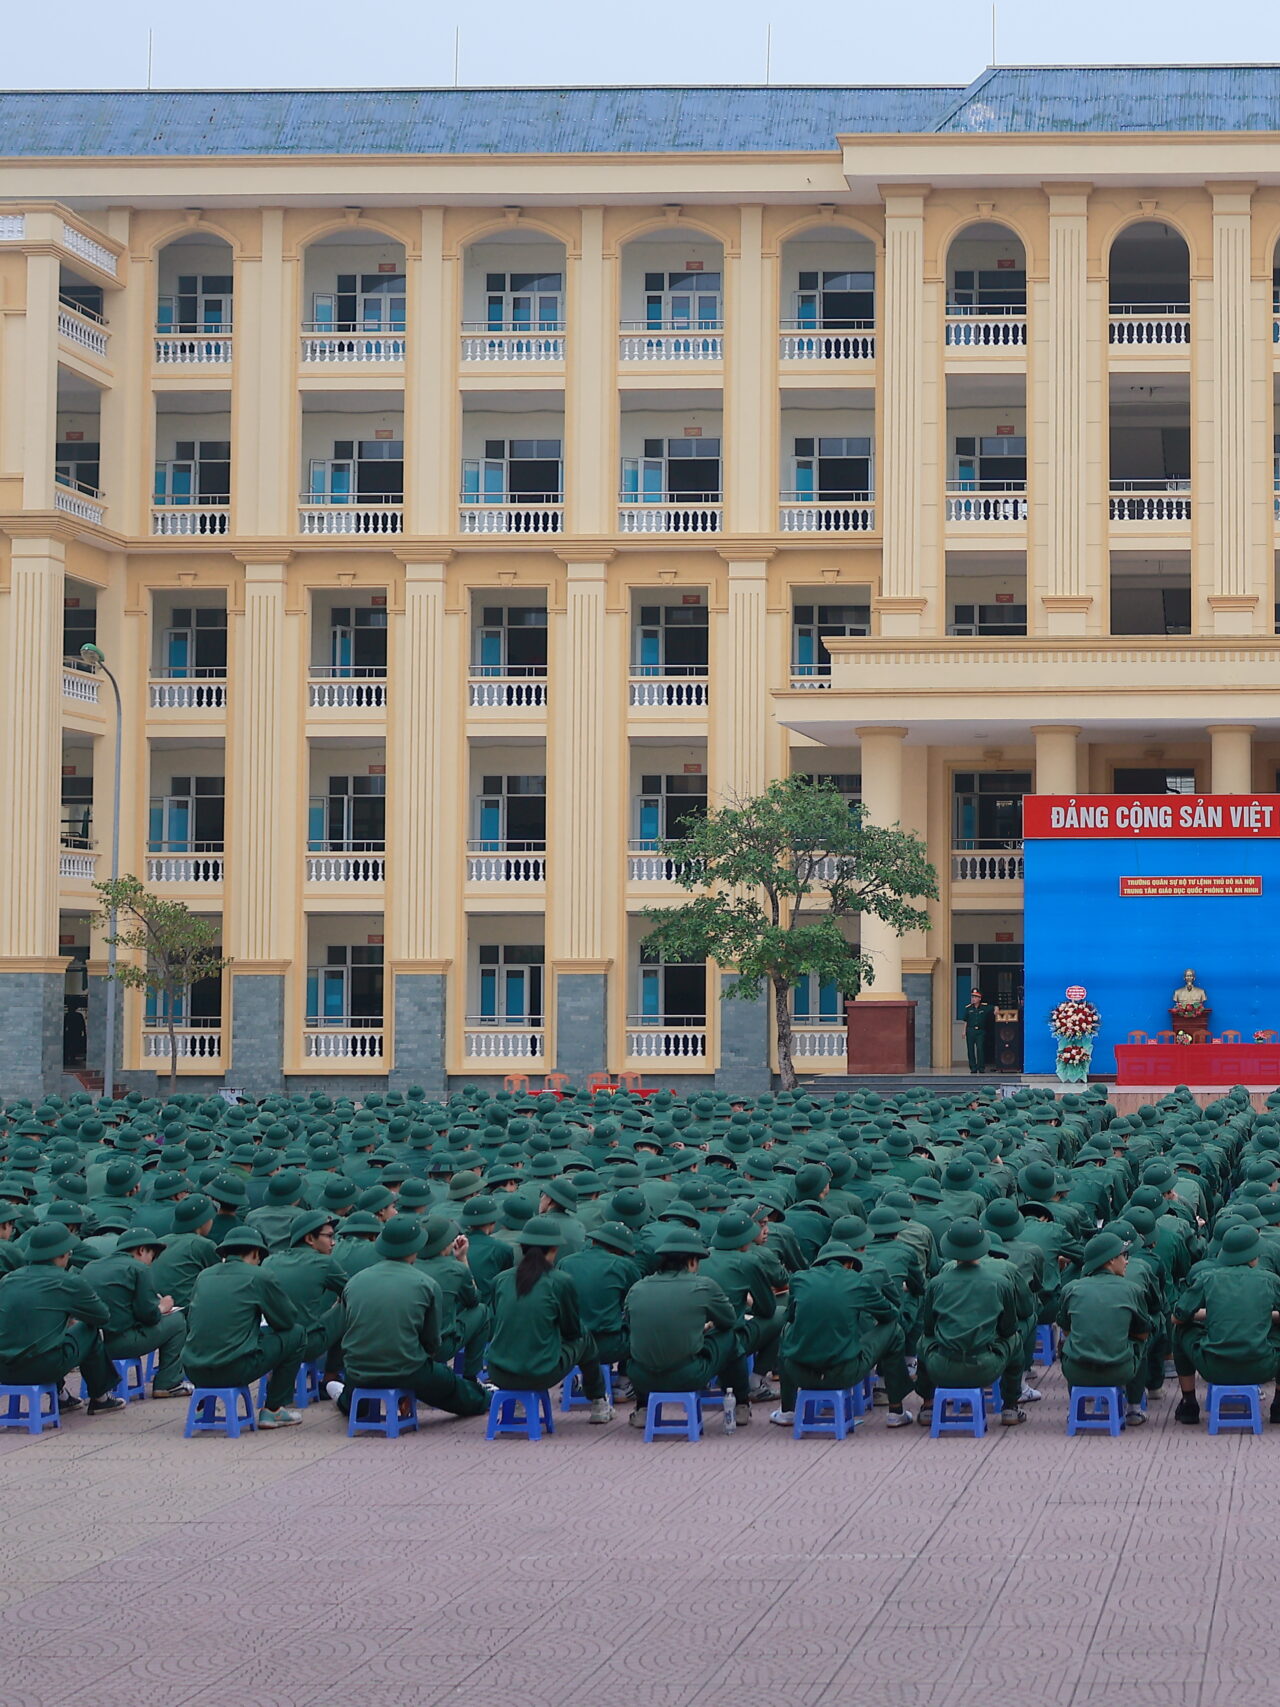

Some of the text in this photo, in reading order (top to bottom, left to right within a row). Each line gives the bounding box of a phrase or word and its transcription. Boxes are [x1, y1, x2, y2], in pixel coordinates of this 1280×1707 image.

[1051, 799, 1109, 828] ĐẢNG
[1116, 802, 1172, 832] CỘNG
[1180, 799, 1222, 828] SẢN
[1230, 801, 1273, 832] VIỆT
